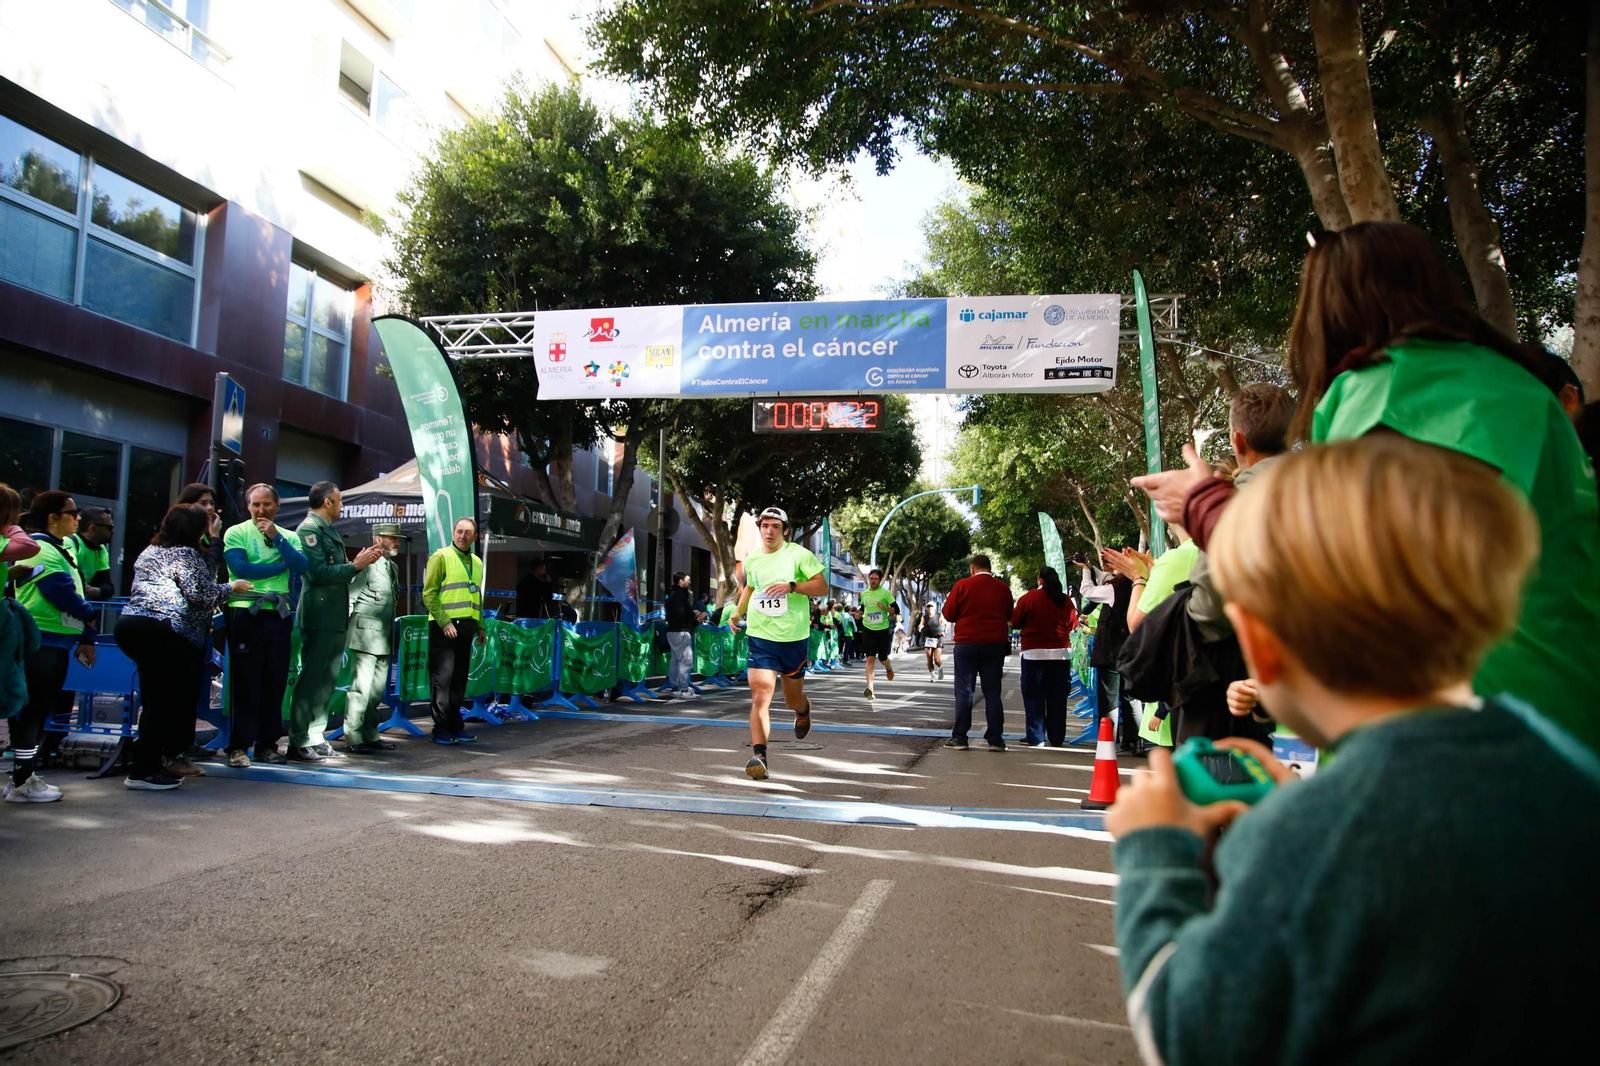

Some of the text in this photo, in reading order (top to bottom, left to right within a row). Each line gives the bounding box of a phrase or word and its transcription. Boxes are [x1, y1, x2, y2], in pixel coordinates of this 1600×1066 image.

[698, 308, 931, 334] Almería en marcha
[978, 308, 1028, 323] cajamar
[697, 336, 898, 360] contra el cáncer
[1026, 337, 1083, 350] Fundación
[1055, 355, 1103, 366] Ejido Motor
[540, 364, 572, 375] ALMERÍA
[916, 366, 940, 374] española
[982, 363, 1007, 371] Toyota
[982, 371, 1034, 379] Alborán Motor
[691, 377, 768, 386] #TodosContraElCáncer
[759, 599, 781, 609] 113
